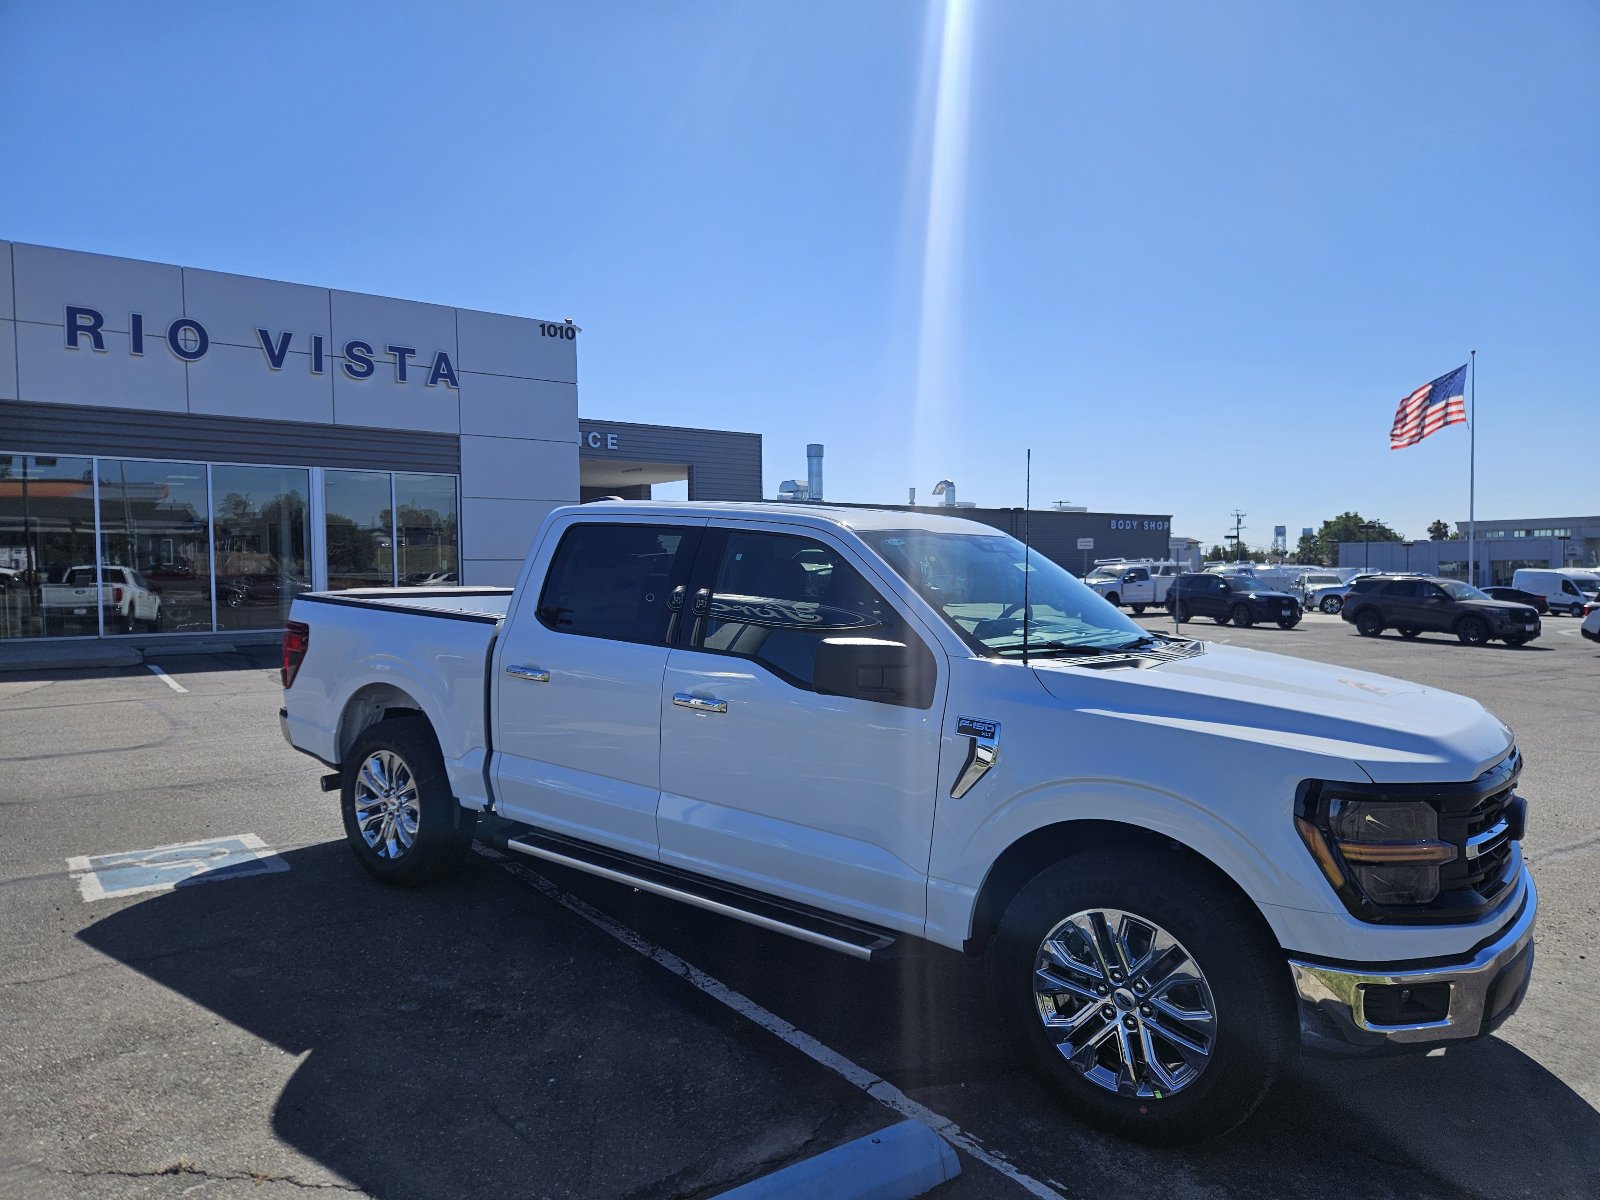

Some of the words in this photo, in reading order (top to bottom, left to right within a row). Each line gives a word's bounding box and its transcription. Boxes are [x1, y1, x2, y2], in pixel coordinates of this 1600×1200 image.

[539, 323, 576, 341] 1010
[64, 305, 209, 361] RIO
[256, 328, 460, 389] VISTA
[1110, 520, 1138, 530] BODY
[1143, 521, 1169, 531] SHOP
[959, 719, 995, 732] F-150
